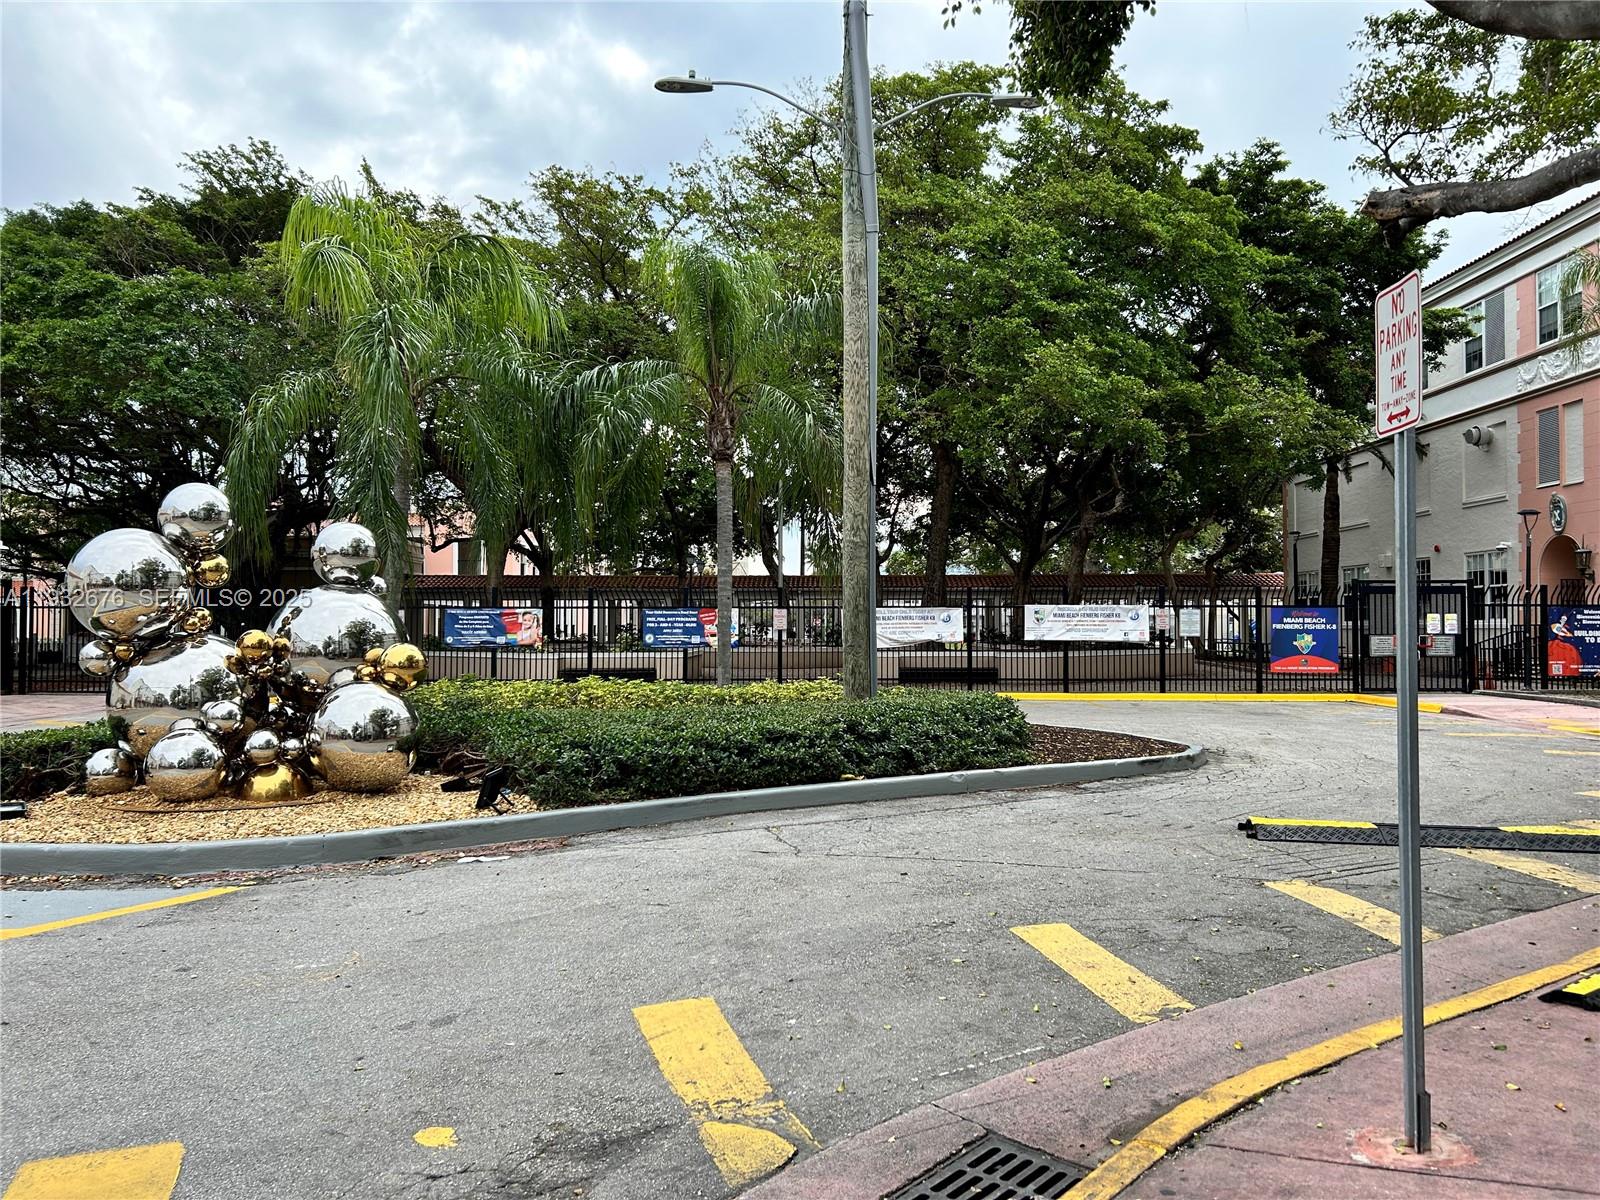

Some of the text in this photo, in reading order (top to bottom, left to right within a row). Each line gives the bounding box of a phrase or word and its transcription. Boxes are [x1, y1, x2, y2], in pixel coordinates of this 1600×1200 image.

[1391, 288, 1405, 319] NO
[1380, 311, 1417, 355] PARKING
[1391, 348, 1406, 372] ANY
[1390, 370, 1407, 394] TIME
